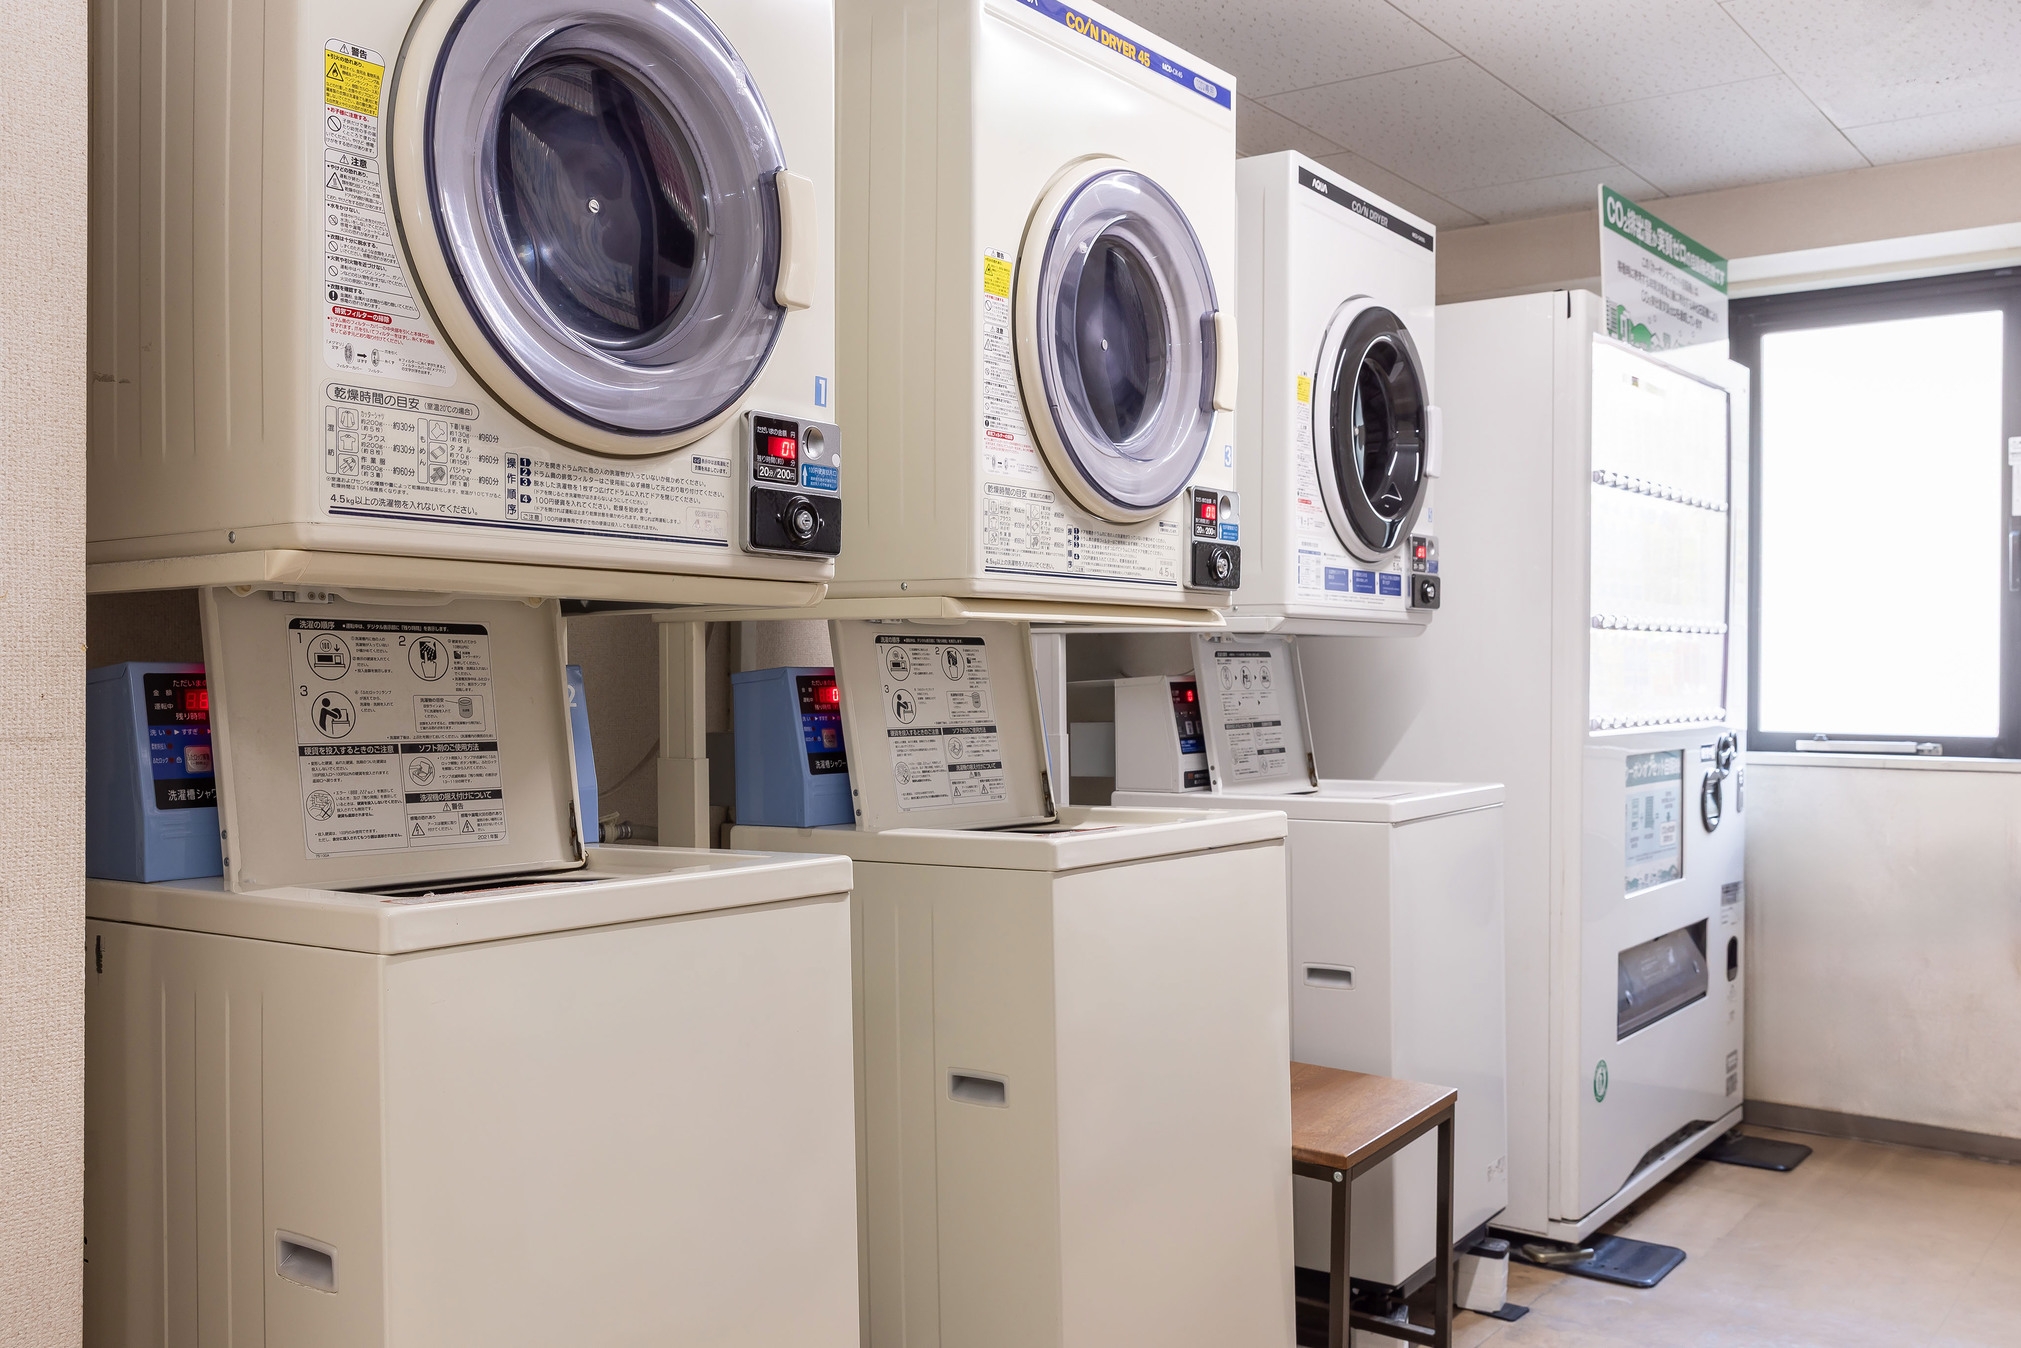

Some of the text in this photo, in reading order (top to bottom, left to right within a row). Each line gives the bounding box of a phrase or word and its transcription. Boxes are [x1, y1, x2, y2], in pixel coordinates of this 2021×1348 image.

[351, 46, 367, 60] 警告
[1101, 30, 1137, 61] DRYER
[1138, 50, 1150, 68] 45
[330, 107, 369, 122] お子様に注意する。
[351, 156, 367, 169] 注意
[330, 203, 360, 215] 水をかけない。
[330, 234, 378, 249] 衣類は十分に脱水する。
[334, 306, 390, 323] 排気フィルターの掃除
[334, 386, 420, 411] 乾燥時間の目安
[393, 421, 416, 432] 約30分
[361, 433, 386, 443] ブラウス
[478, 432, 500, 444] 約60分
[393, 444, 416, 455] 約30分
[419, 435, 427, 467] もめん
[450, 444, 472, 453] タオル
[478, 454, 500, 465] 約60分
[393, 467, 416, 477] 約60分
[449, 465, 472, 475] パジャマ
[478, 476, 500, 487] 約60分
[507, 457, 517, 516] 操作順序
[330, 493, 478, 516] 4.5kg以上の洗濯物を入れないでください。
[299, 620, 335, 630] 洗濯の順序
[398, 635, 407, 646] 2
[299, 685, 309, 697] 3
[567, 684, 577, 708] 2
[304, 746, 394, 756] 硬貨を投入するときのご注意
[418, 742, 480, 752] ソフト剤のご使用方法
